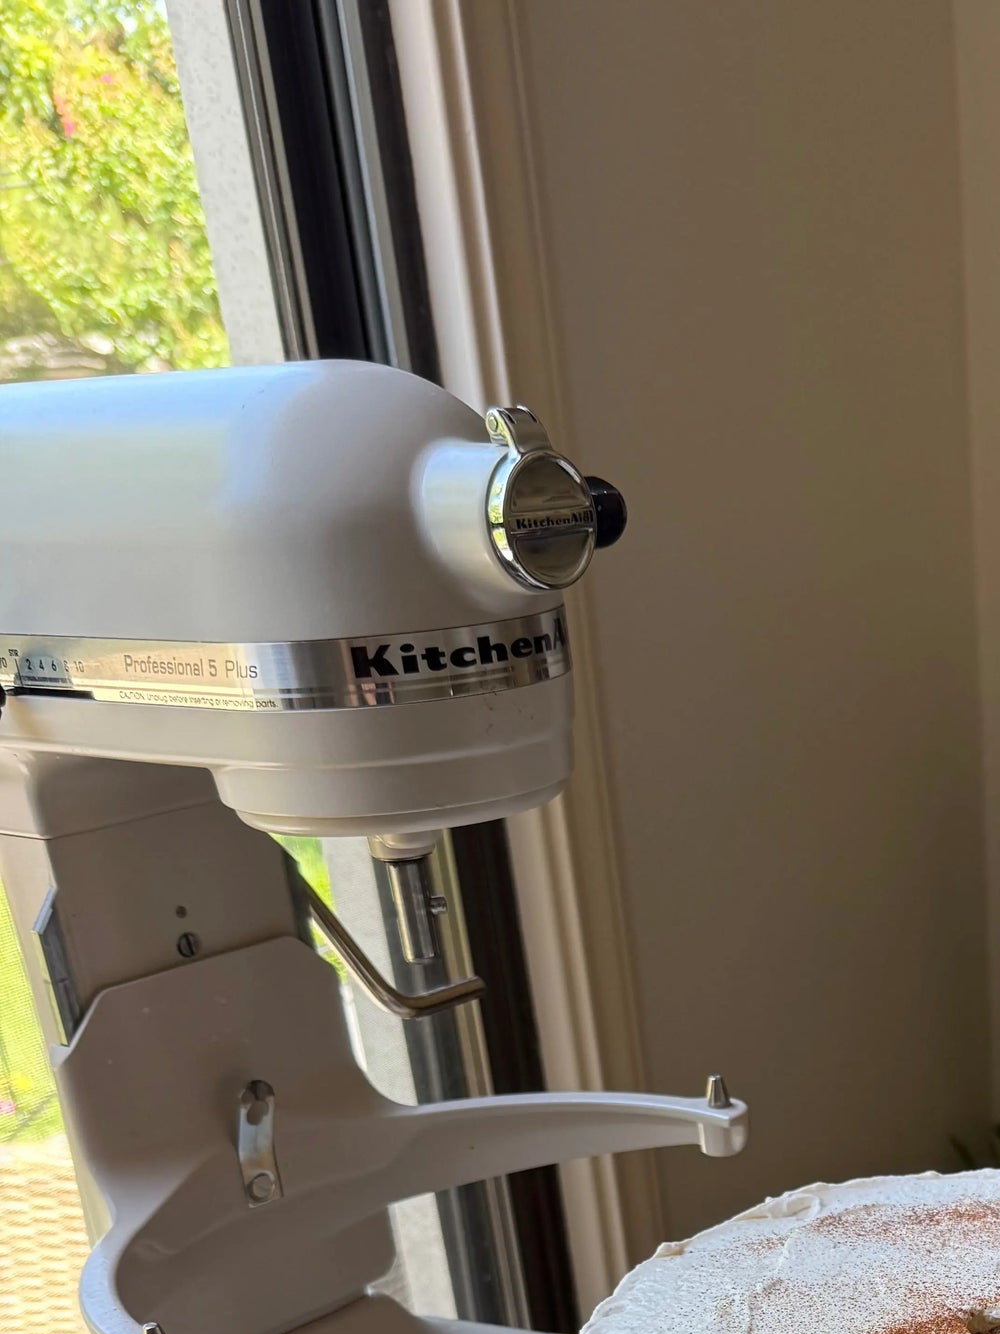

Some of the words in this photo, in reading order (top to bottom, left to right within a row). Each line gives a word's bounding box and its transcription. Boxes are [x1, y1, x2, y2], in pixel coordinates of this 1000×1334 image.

[350, 618, 564, 679] KitchenA
[26, 658, 32, 670] 2
[39, 659, 44, 671] 4
[52, 659, 57, 671] 6
[124, 654, 203, 677] Professional
[208, 659, 217, 677] 5
[225, 659, 258, 679] Plus
[256, 699, 278, 709] parts.
